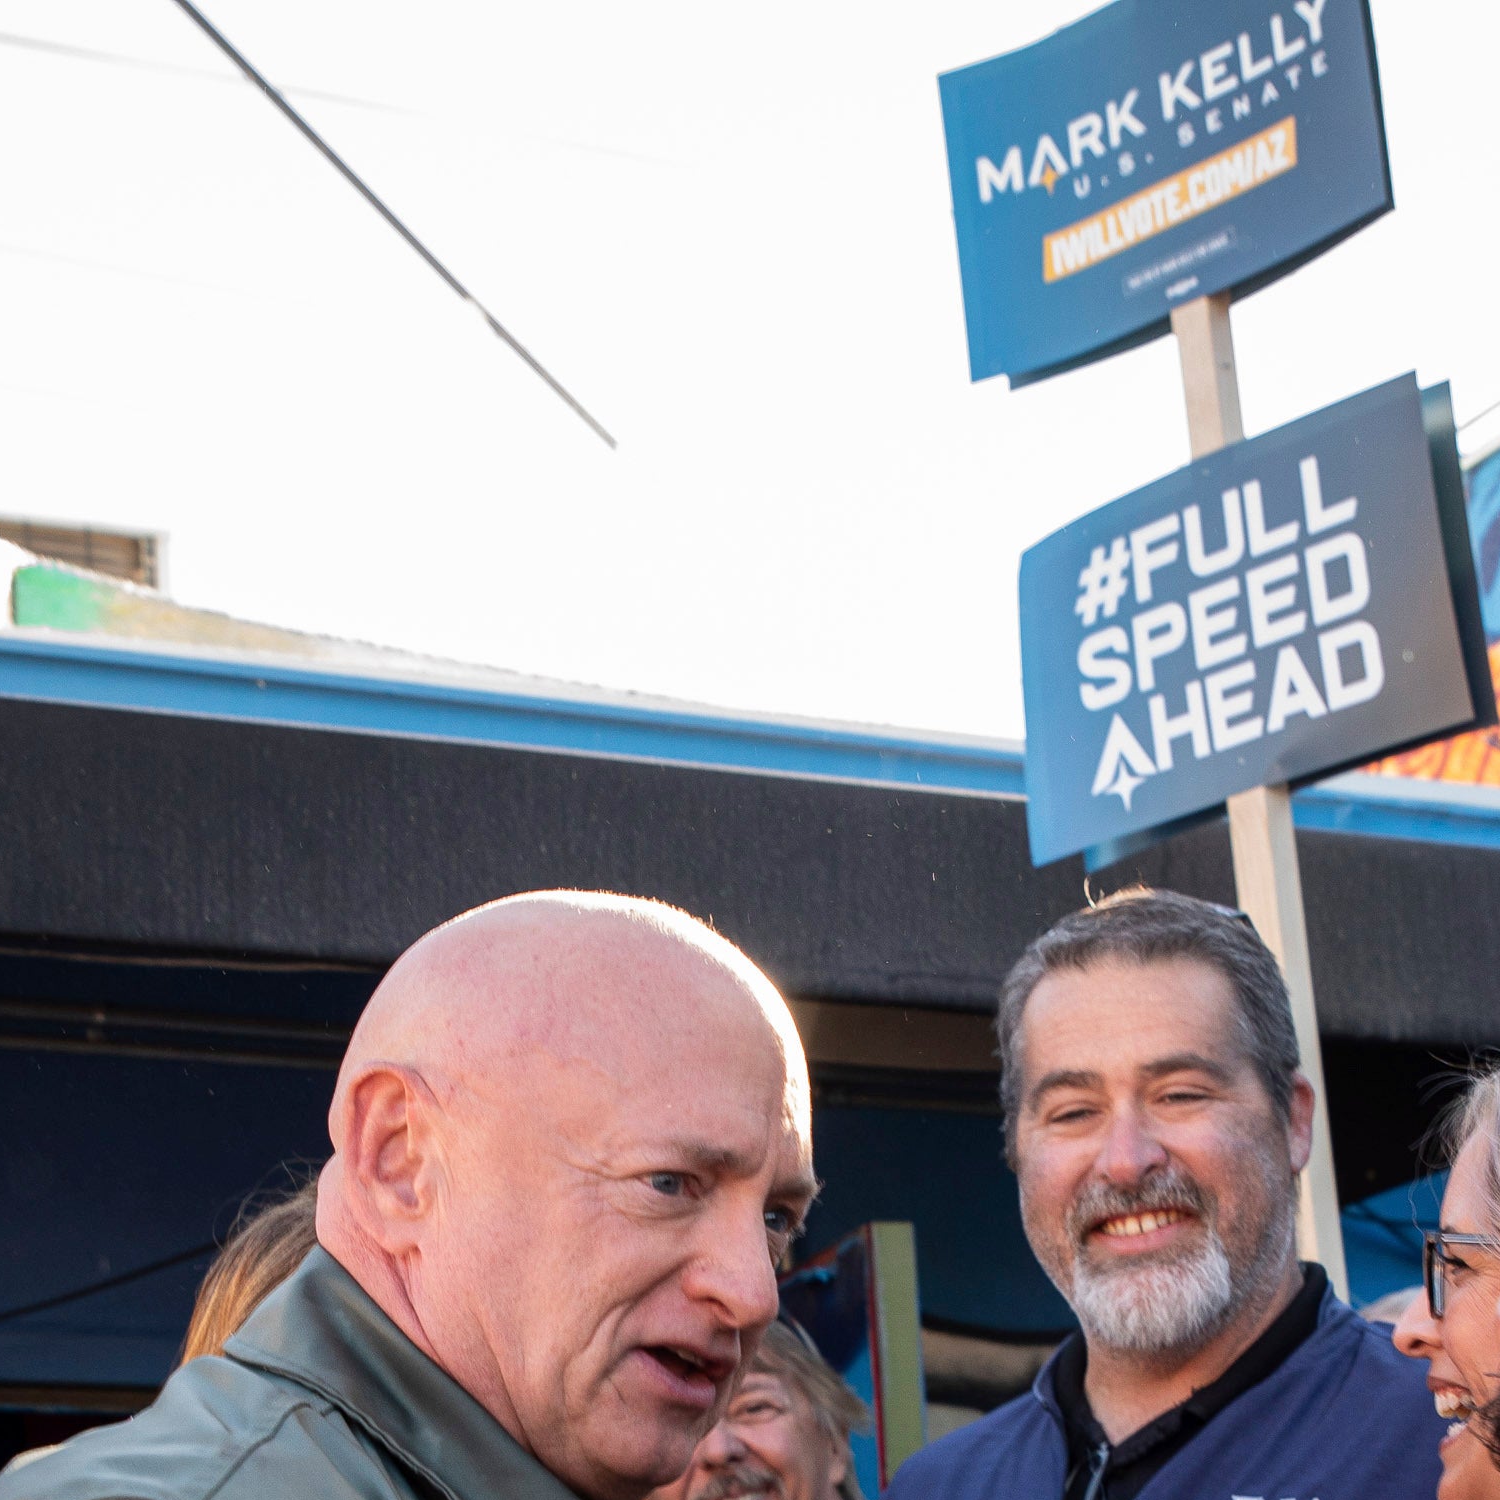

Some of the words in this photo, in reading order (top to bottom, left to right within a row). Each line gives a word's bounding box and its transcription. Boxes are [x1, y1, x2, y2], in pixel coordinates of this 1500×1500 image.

[975, 88, 1148, 204] MARK
[1158, 0, 1329, 123] KELLY
[1177, 50, 1331, 148] SENATE
[1050, 126, 1296, 277] IWILLVOTE.COM/AZ
[1073, 454, 1359, 627] #FULL
[1076, 531, 1371, 712] SPEED
[1090, 619, 1386, 798] AHEAD
